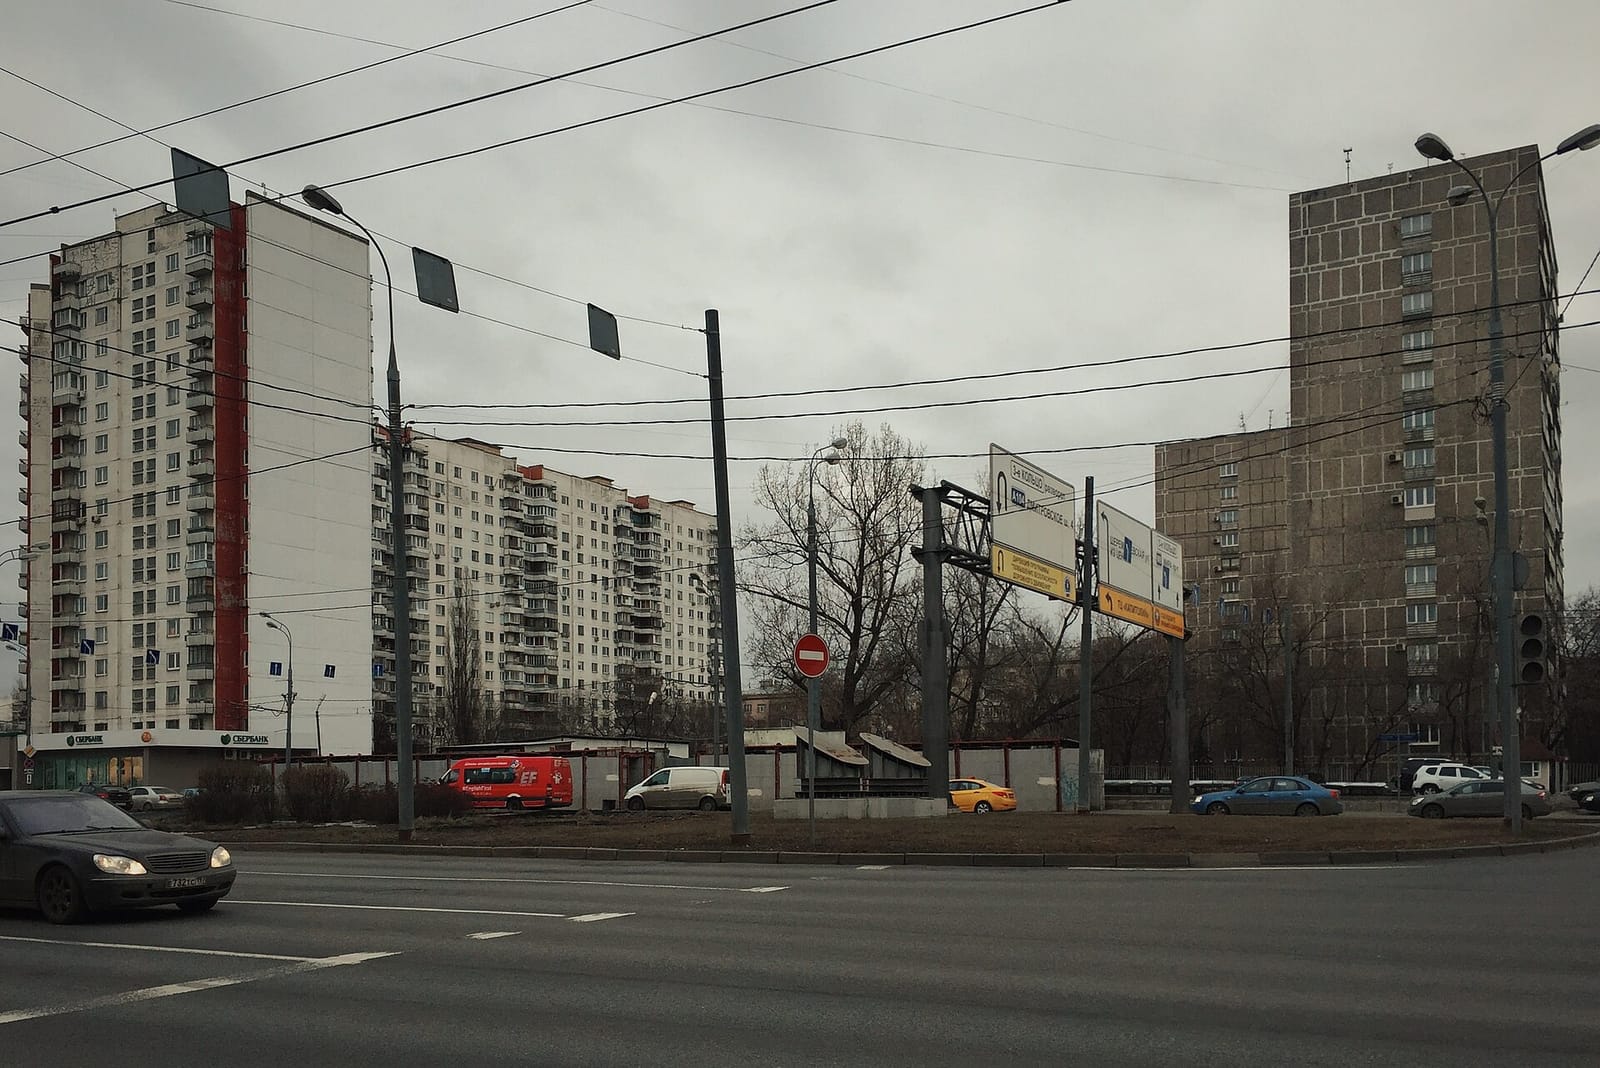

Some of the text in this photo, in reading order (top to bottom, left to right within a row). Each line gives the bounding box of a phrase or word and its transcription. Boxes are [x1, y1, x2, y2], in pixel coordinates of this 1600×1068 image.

[1021, 469, 1043, 489] КОЛЬЦО
[75, 735, 104, 744] СБЕРБАНК
[232, 735, 269, 743] СБЕРБАНК
[521, 771, 538, 785] EF
